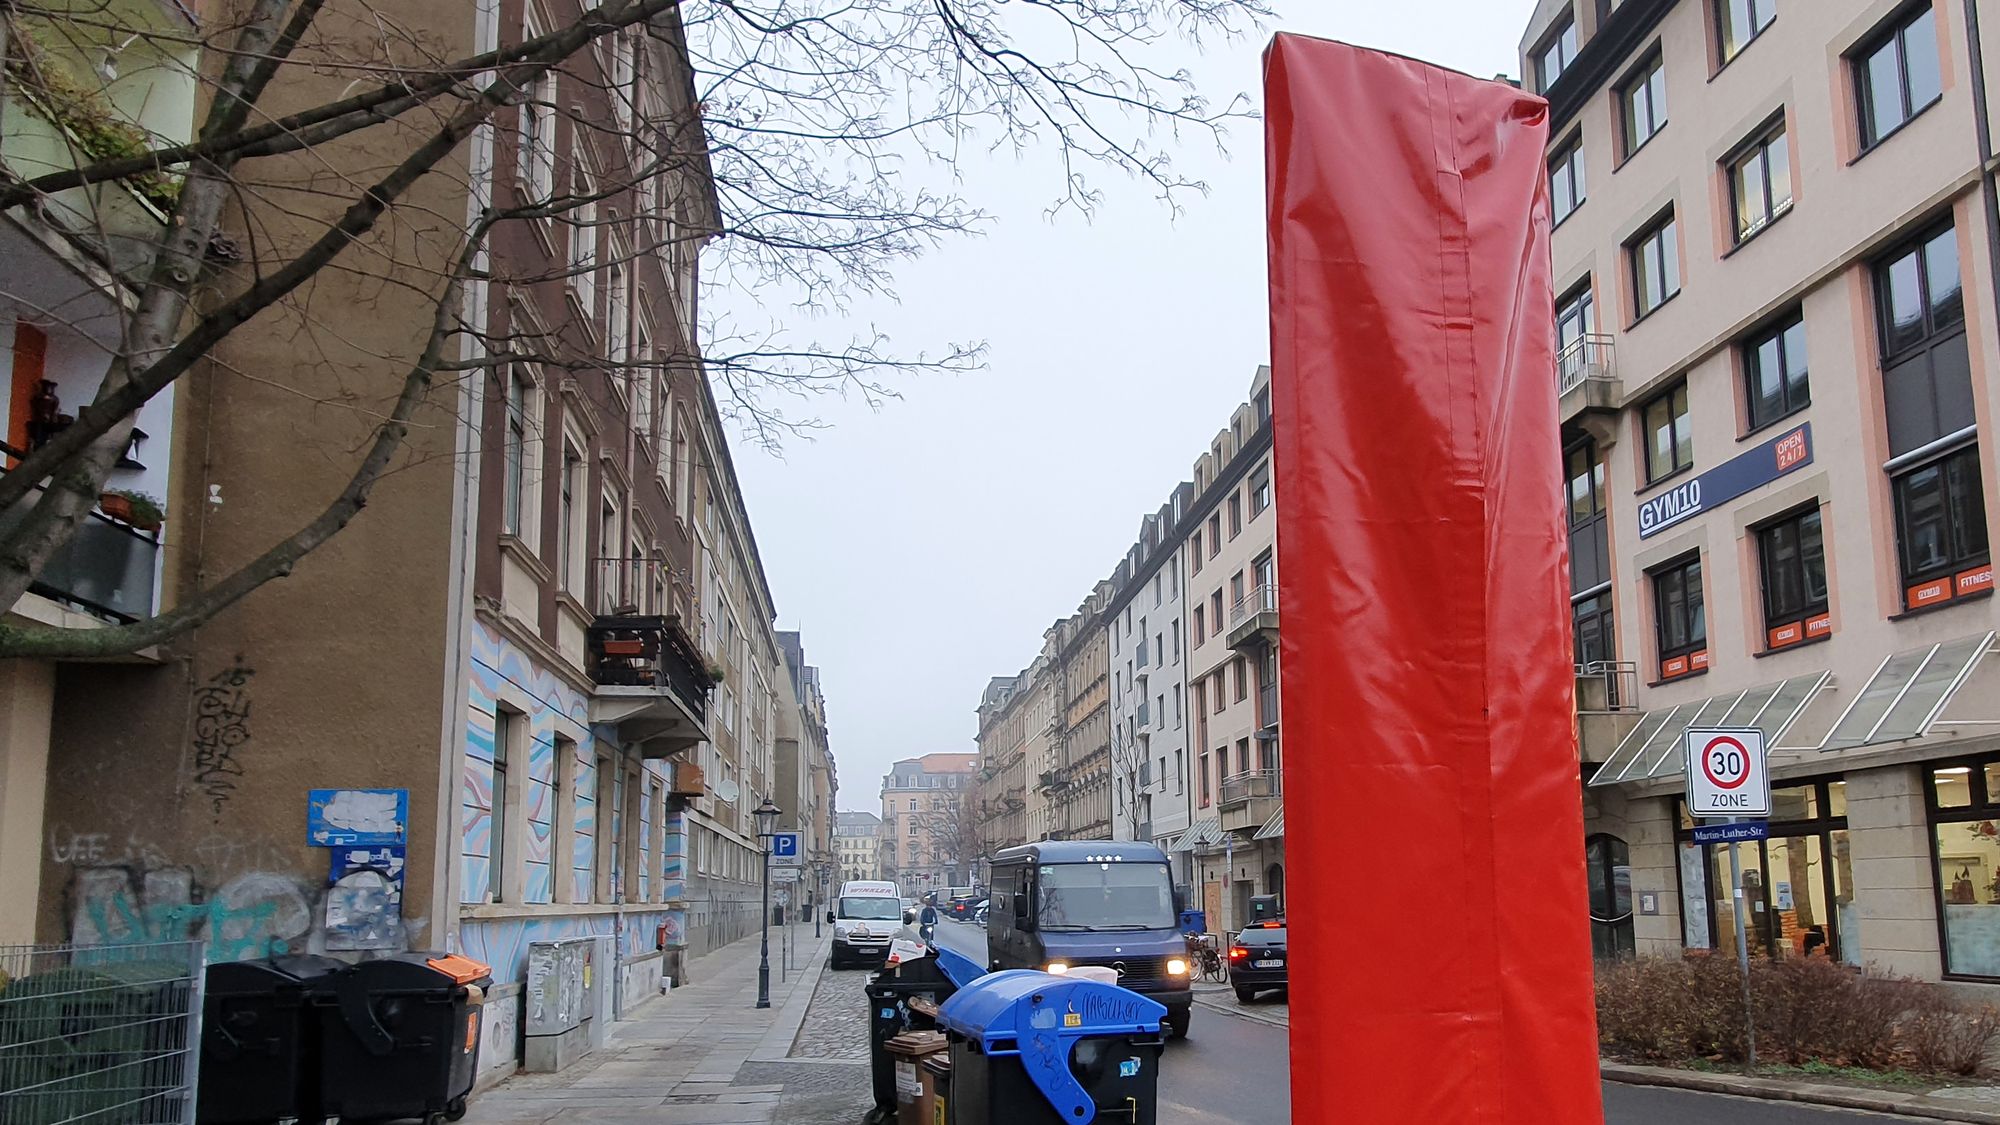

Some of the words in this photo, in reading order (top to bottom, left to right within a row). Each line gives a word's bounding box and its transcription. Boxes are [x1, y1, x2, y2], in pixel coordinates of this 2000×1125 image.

[1777, 432, 1802, 455] OPEN
[1780, 444, 1803, 467] 24/7
[1639, 479, 1701, 530] GYM10
[1960, 570, 1993, 588] FITNES
[1712, 751, 1741, 776] 30
[1711, 793, 1749, 807] ZONE
[1694, 826, 1764, 841] Martin-Luther-Str.
[779, 837, 792, 854] P
